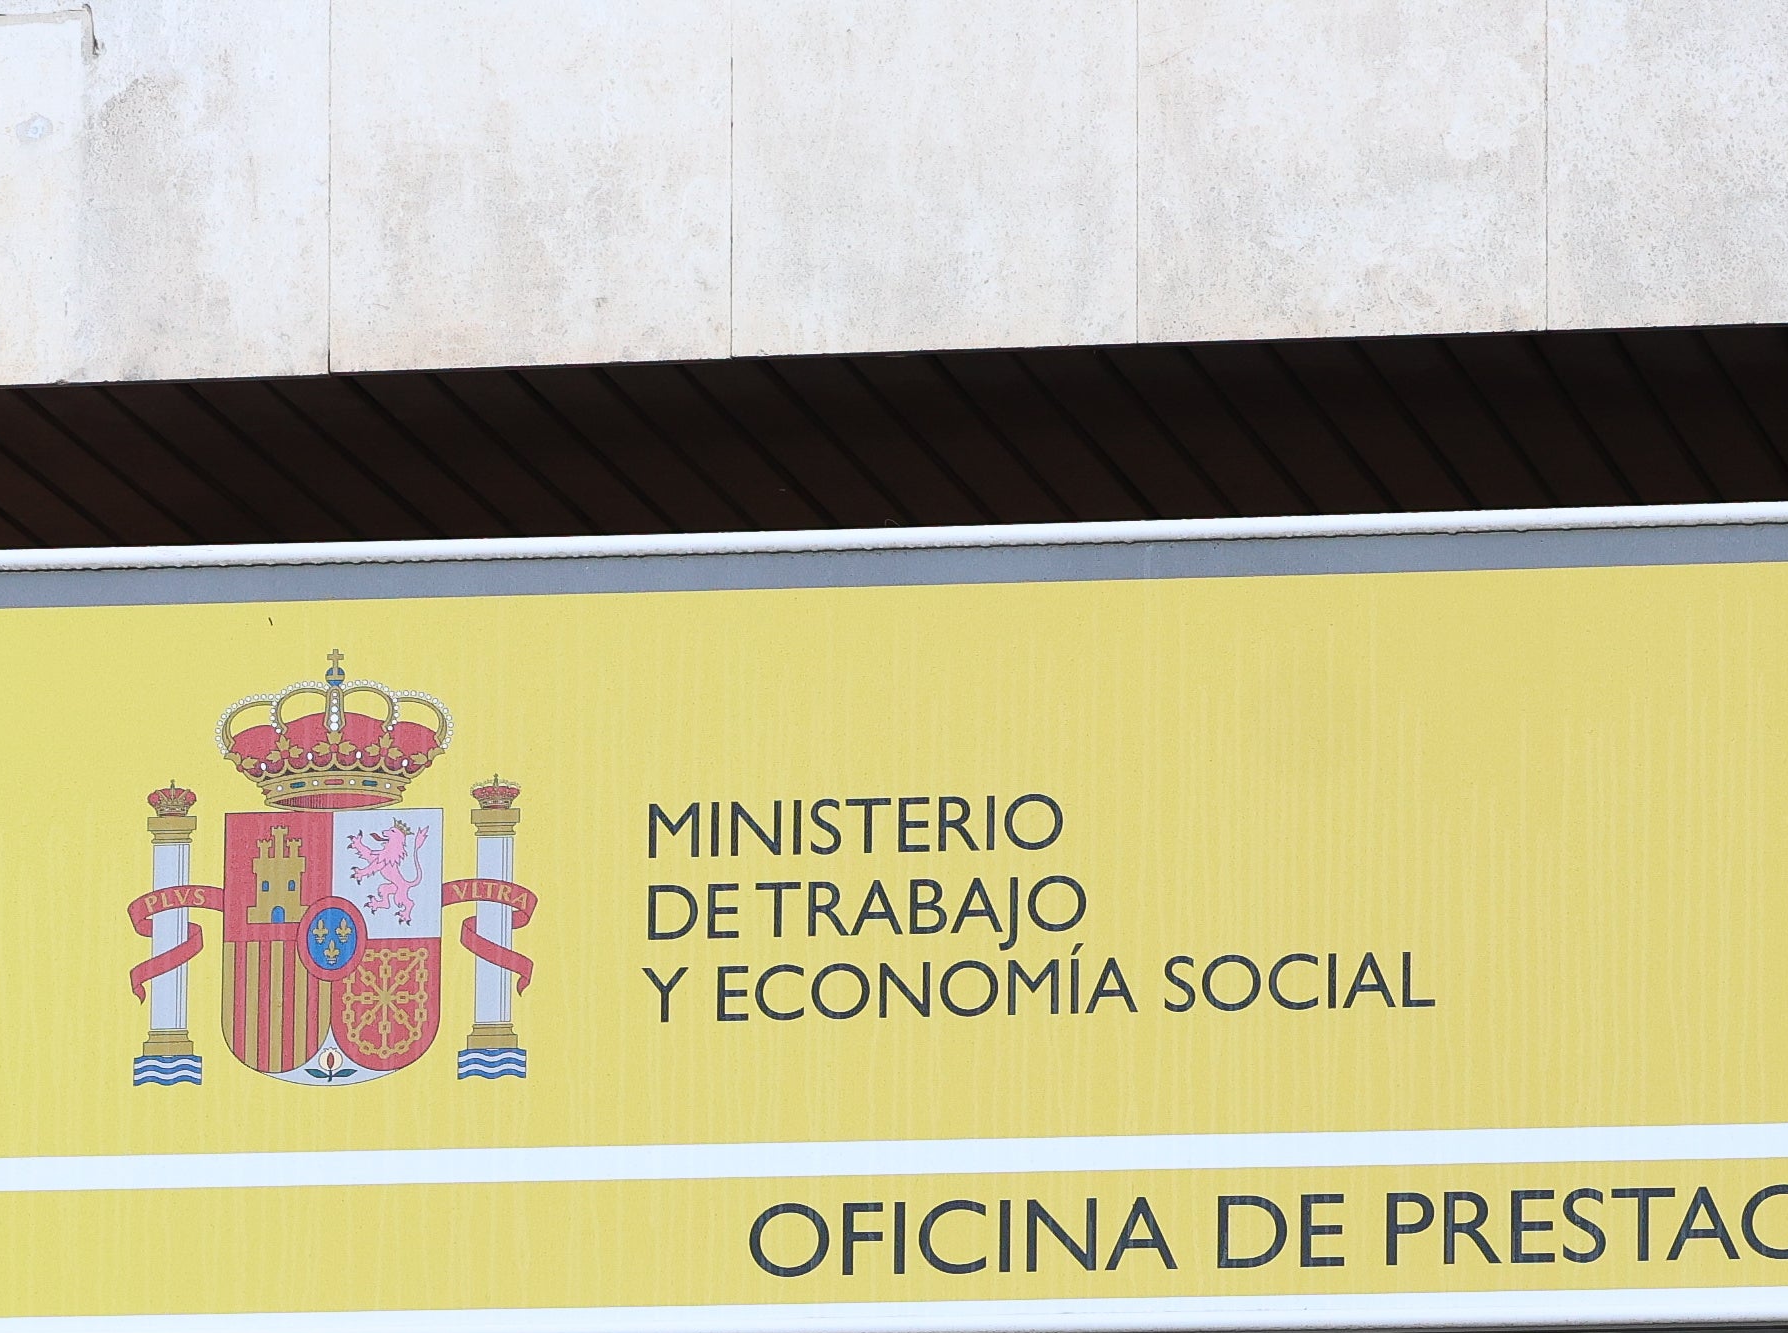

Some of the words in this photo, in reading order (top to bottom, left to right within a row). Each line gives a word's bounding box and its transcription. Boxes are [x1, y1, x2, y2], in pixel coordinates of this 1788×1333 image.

[648, 793, 1063, 858] MINISTERIO
[144, 886, 207, 914] PLVS
[451, 881, 530, 911] VLTRA
[648, 882, 739, 941] DE
[758, 874, 1086, 951] TRABAJO
[642, 966, 689, 1023] Y
[716, 943, 1138, 1021] ECONOMÍA
[1163, 950, 1436, 1013] SOCIAL
[748, 1196, 1177, 1277] OFICINA
[1217, 1192, 1345, 1269] DE
